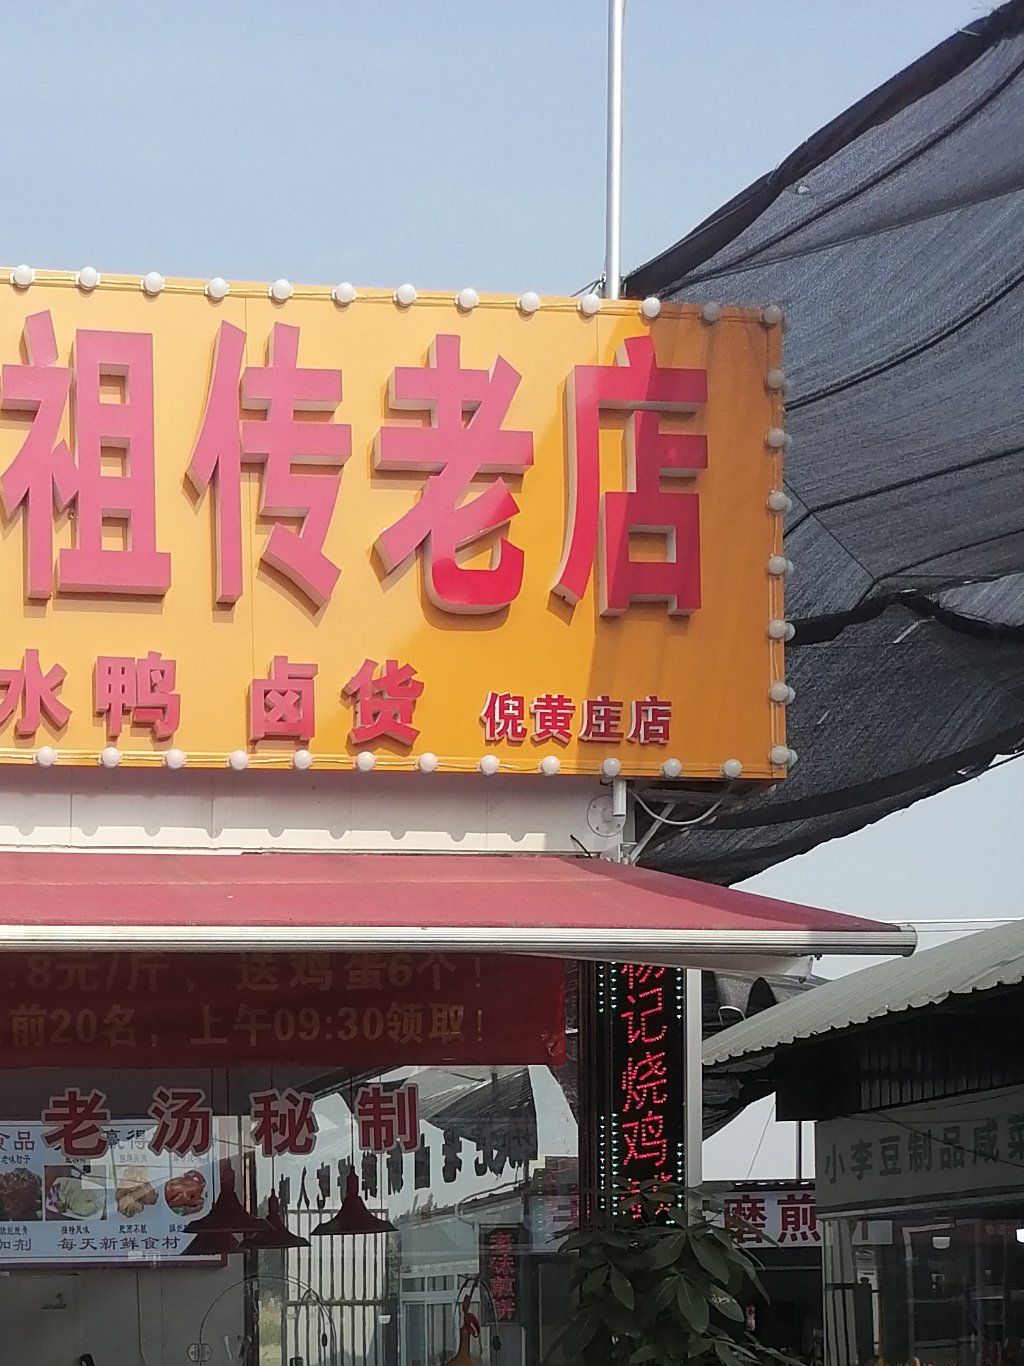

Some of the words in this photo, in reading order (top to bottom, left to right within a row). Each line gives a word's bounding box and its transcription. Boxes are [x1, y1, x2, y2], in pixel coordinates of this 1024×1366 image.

[249, 655, 424, 747] 卤货
[480, 692, 672, 744] 倪黄庄店
[40, 1083, 420, 1160] 老汤秘制
[57, 1236, 181, 1251] 每天新鲜食材
